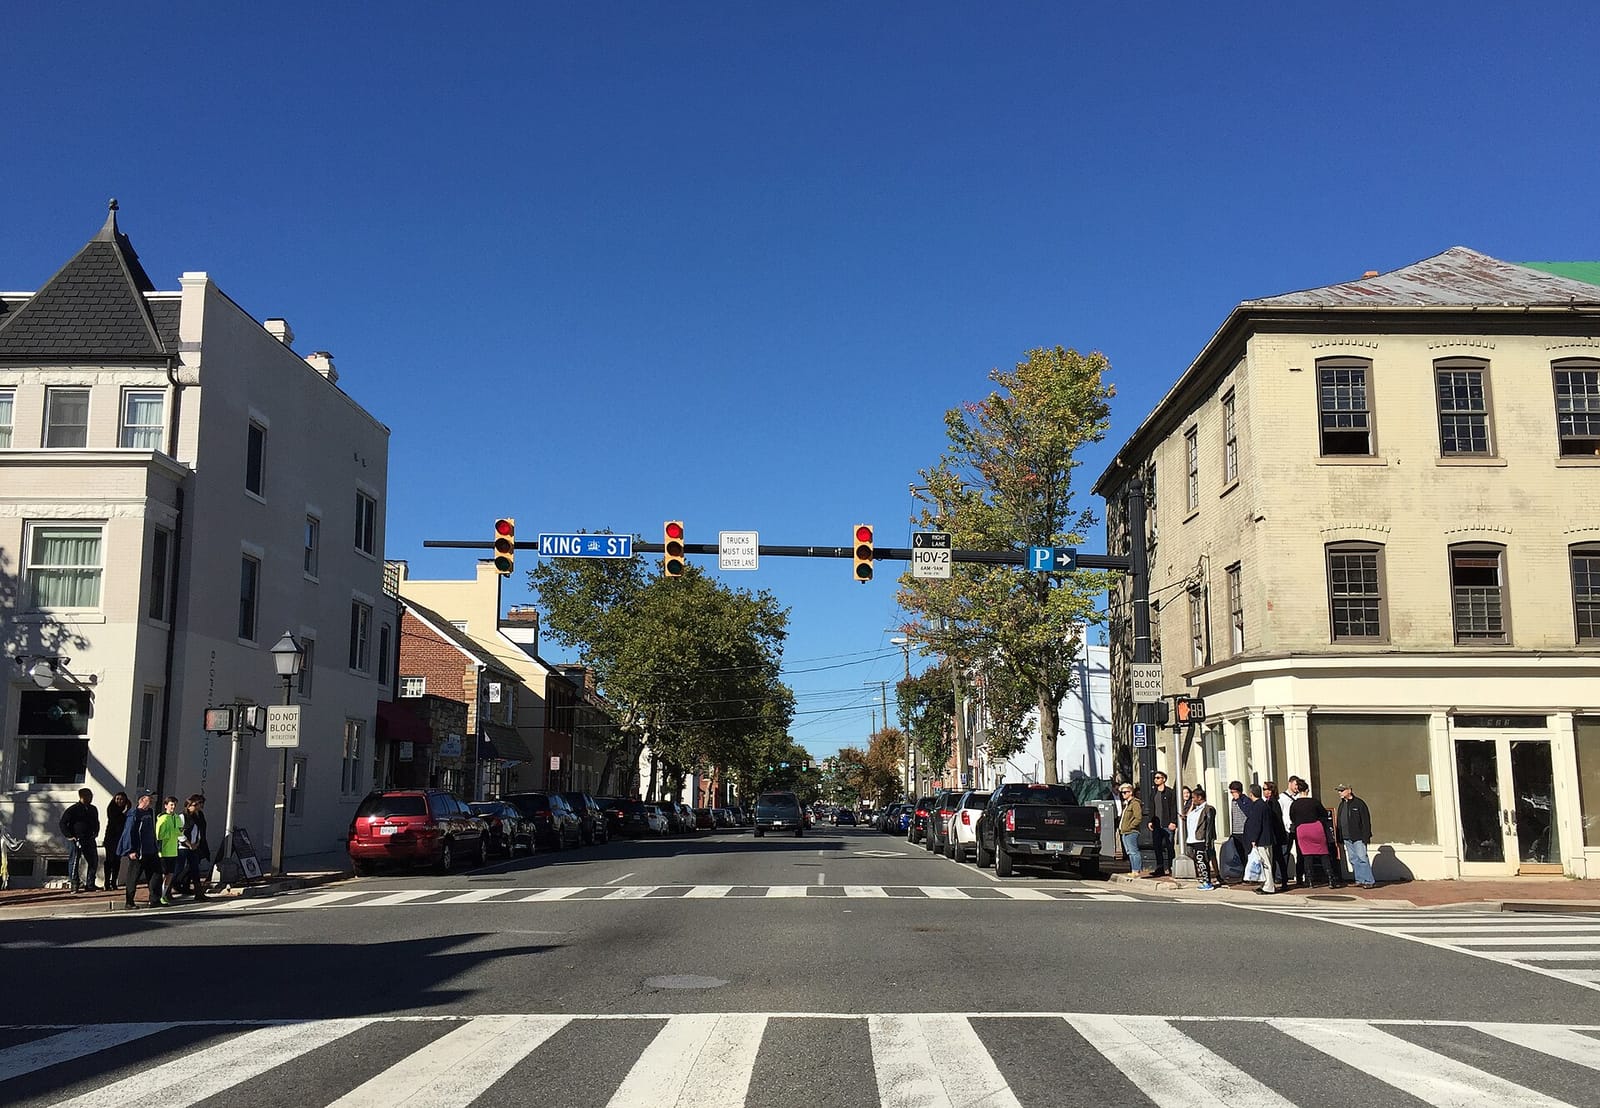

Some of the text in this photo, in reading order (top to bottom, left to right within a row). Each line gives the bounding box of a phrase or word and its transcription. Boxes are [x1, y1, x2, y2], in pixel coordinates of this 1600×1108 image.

[543, 537, 628, 555] KING ST
[722, 547, 754, 555] MUST USE
[915, 551, 949, 563] HOV-2
[1033, 548, 1050, 569] P
[1133, 670, 1161, 678] DO NOT
[1134, 680, 1161, 689] BLOCK
[269, 712, 297, 721] DO NOT
[270, 723, 297, 732] BLOCK
